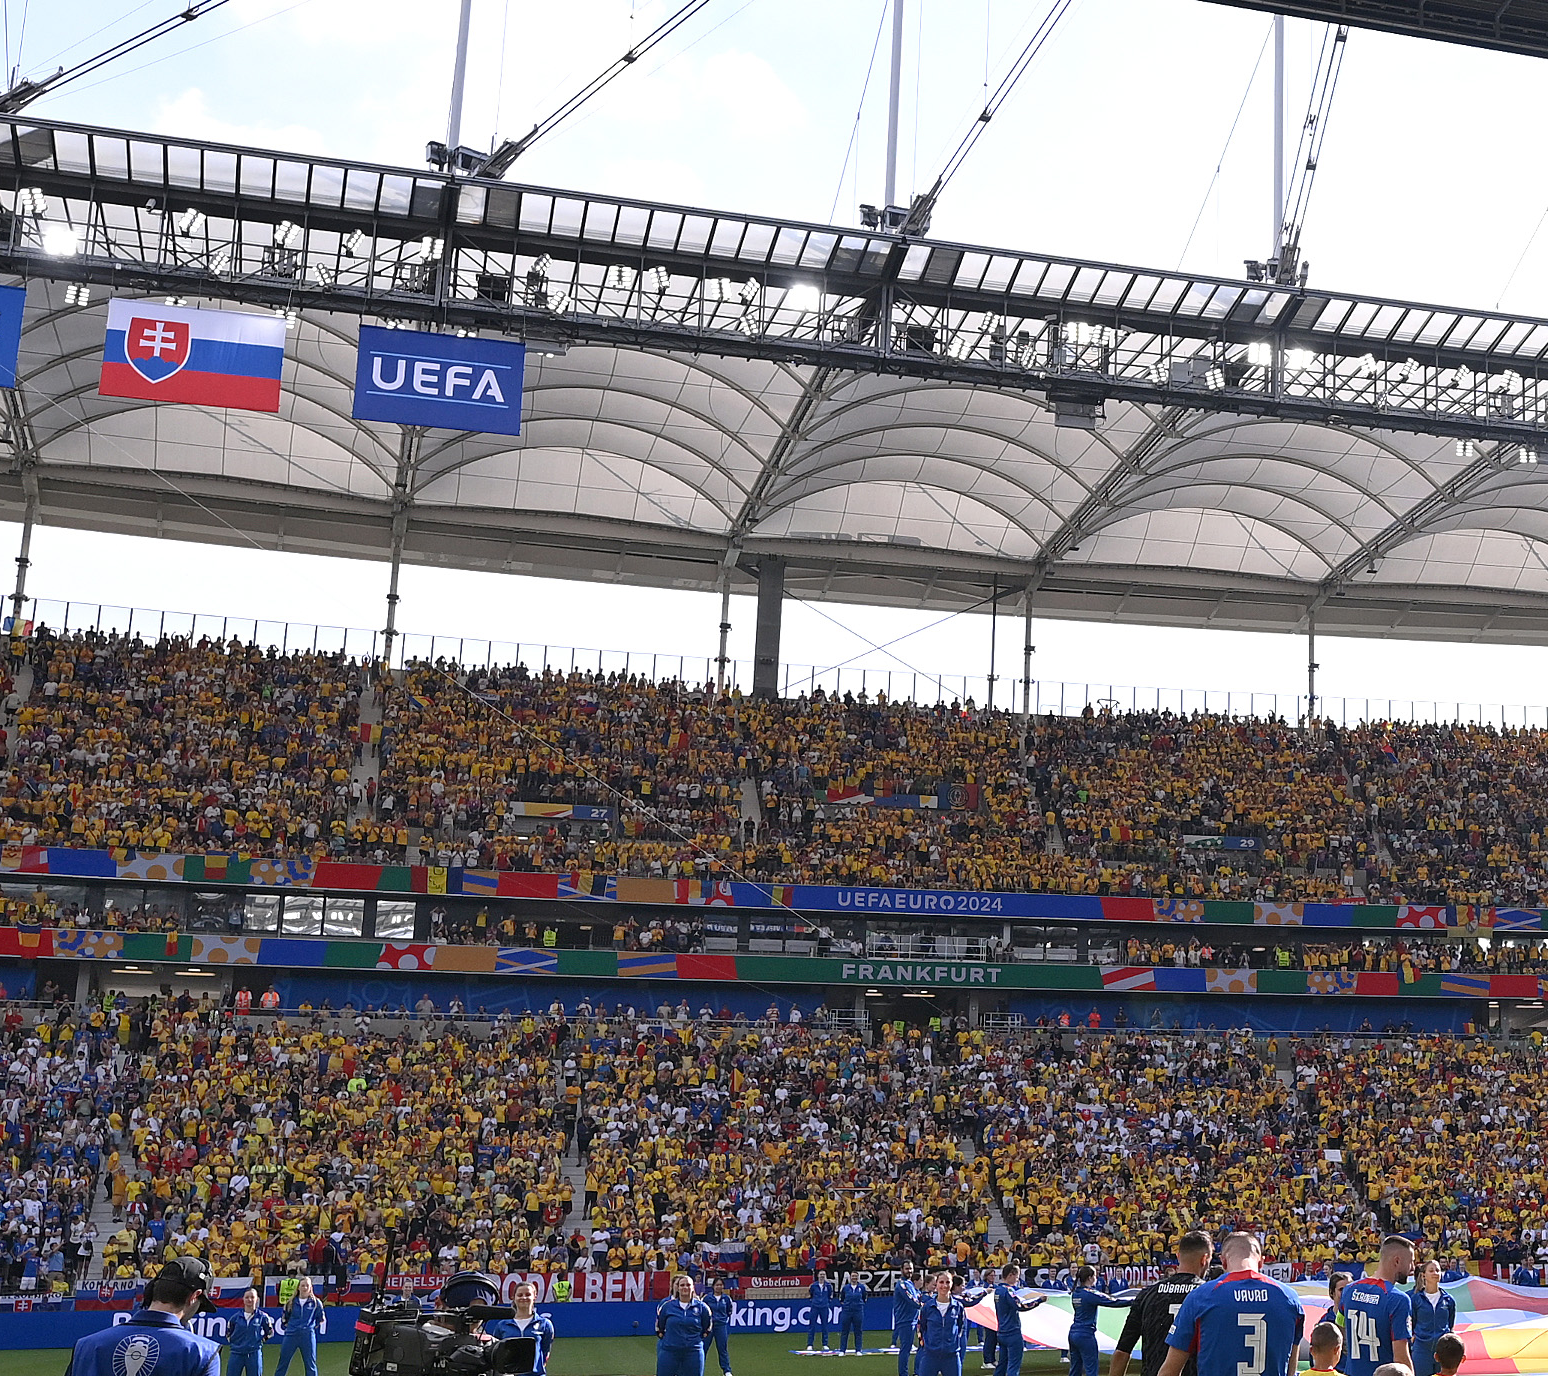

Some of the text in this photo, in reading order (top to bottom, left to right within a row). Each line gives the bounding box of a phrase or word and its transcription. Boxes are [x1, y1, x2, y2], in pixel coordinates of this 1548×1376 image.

[372, 357, 505, 403] UEFA
[590, 809, 608, 818] 27
[1240, 839, 1255, 848] 29
[842, 964, 1002, 983] FRANKFURT
[1234, 1289, 1269, 1303] VAVRO
[1347, 1308, 1381, 1362] 14
